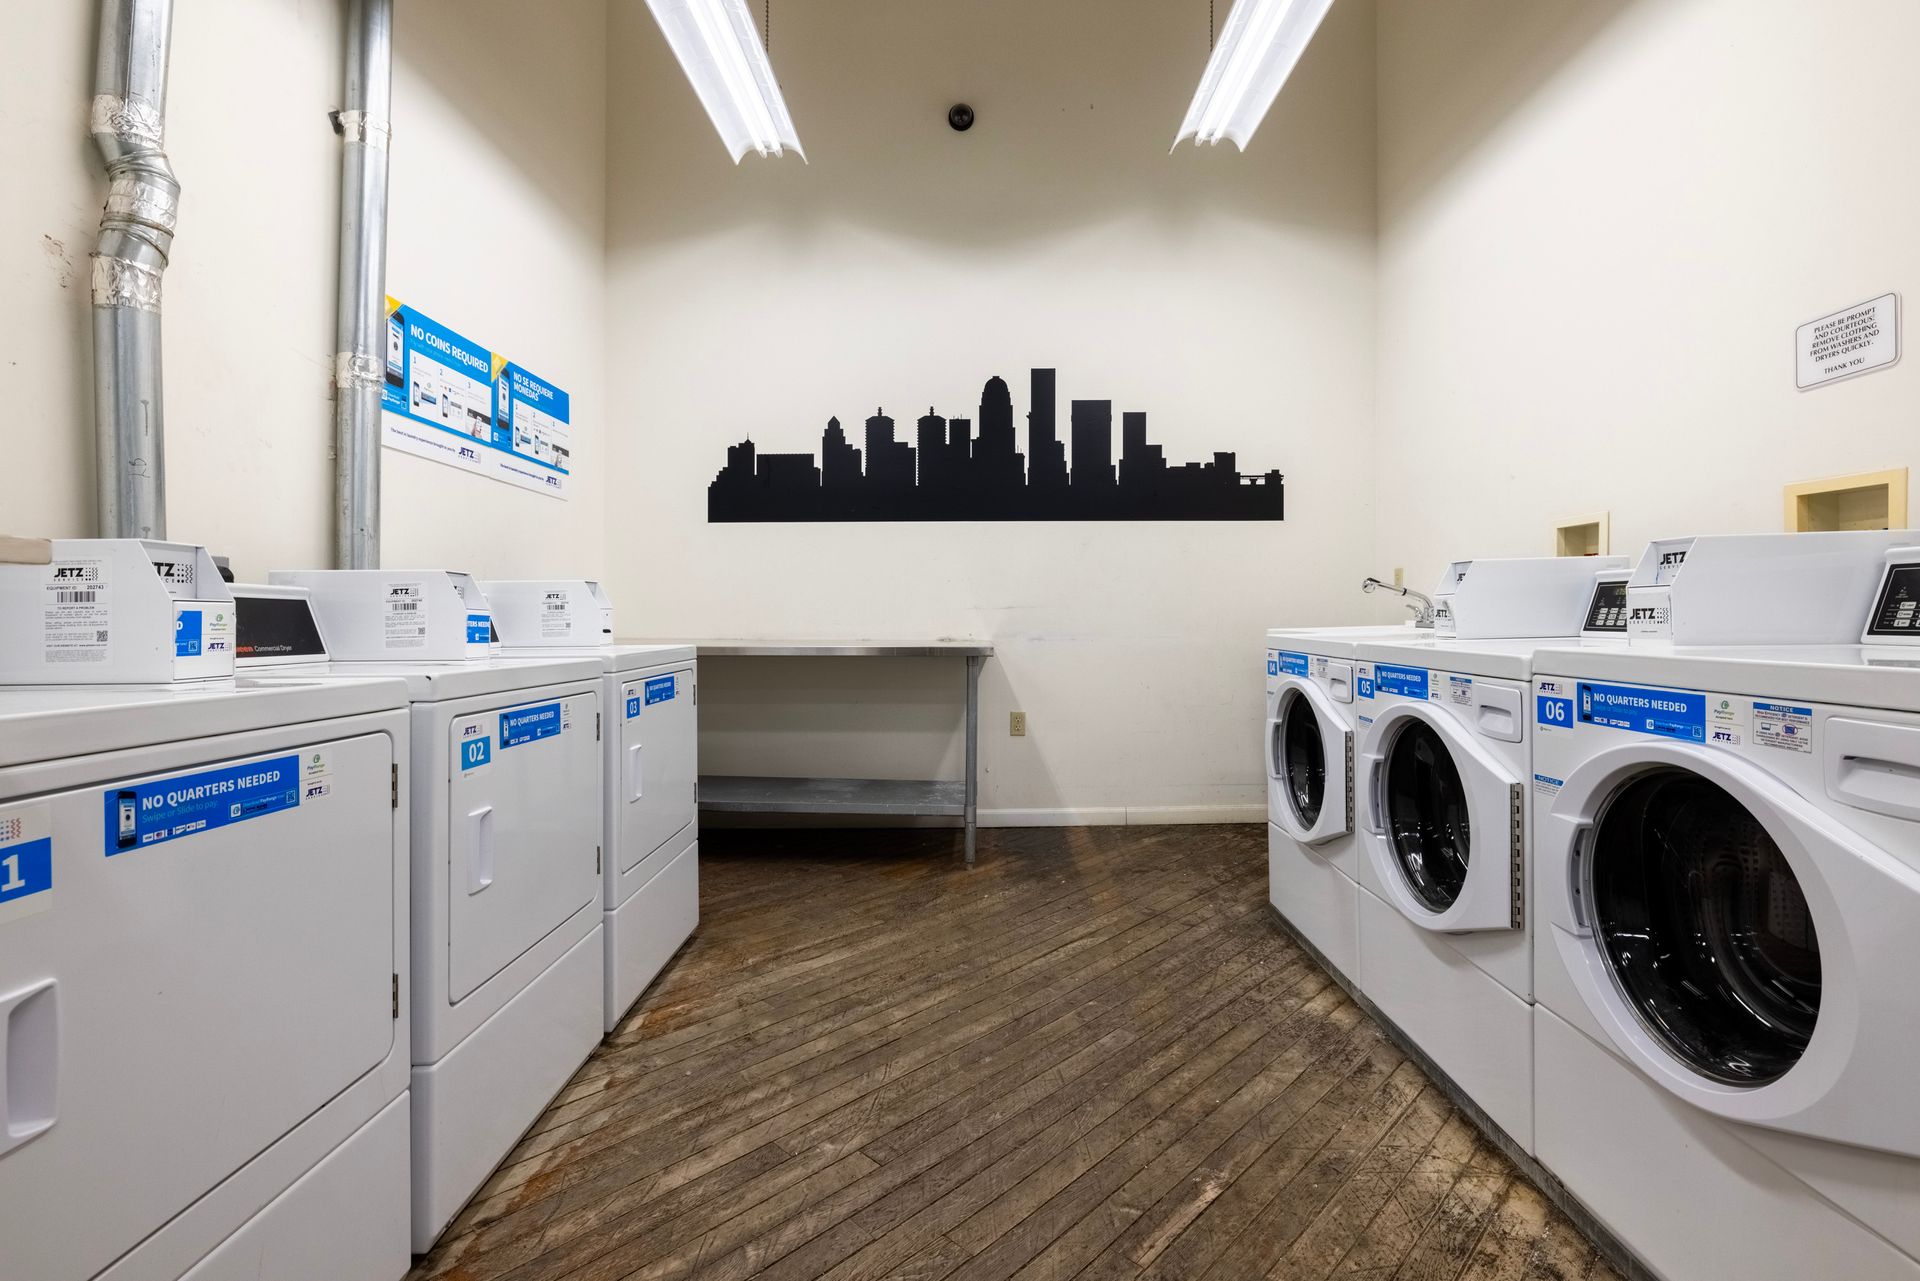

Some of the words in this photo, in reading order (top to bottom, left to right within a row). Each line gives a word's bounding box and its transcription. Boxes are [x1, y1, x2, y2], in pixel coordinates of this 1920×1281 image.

[1814, 322, 1837, 334] PLEASE
[1838, 317, 1845, 325] BE
[1846, 307, 1876, 322] PROMPT
[1810, 346, 1829, 356] FROM
[1831, 335, 1862, 350] WASHERS
[1863, 329, 1880, 341] AND
[1812, 336, 1840, 349] REMOVE
[1841, 322, 1877, 339] CLOTHING
[1815, 332, 1829, 341] AND
[410, 324, 424, 343] NO
[426, 333, 451, 355] COINS
[451, 346, 489, 374] REQUIRED
[1815, 351, 1840, 362] DRYERS
[1842, 341, 1874, 354] QUICKLY.
[1824, 363, 1848, 374] THANK
[1849, 357, 1865, 366] YOU
[513, 371, 522, 383] NO
[522, 376, 530, 387] SE
[529, 379, 554, 400] REQUIERE
[513, 381, 539, 401] MONEDAS
[459, 447, 474, 460] JETZ
[1660, 551, 1686, 566] JETZ
[54, 568, 83, 578] JETZ
[152, 562, 175, 577] TZ
[1629, 608, 1655, 619] JETZ
[1387, 673, 1406, 681] QUARTERS
[1405, 674, 1421, 682] NEEDED
[1361, 681, 1371, 694] 05
[1539, 682, 1555, 692] JETZ
[629, 700, 638, 714] 03
[1593, 692, 1605, 702] NO
[1606, 695, 1650, 708] QUARTERS
[1651, 699, 1687, 713] NEEDED
[1770, 705, 1793, 713] NOTICE
[1545, 700, 1565, 721] 06
[510, 718, 517, 726] NO
[518, 714, 539, 727] QUARTERS
[539, 711, 554, 721] NEEDED
[463, 725, 477, 735] JETZ
[1713, 732, 1731, 741] JETZ
[469, 741, 484, 762] 02
[142, 794, 164, 811] NO
[167, 779, 235, 808] QUARTERS
[237, 770, 281, 790] NEEDED
[306, 786, 322, 797] JETZ
[260, 795, 277, 804] PayRange
[142, 810, 166, 824] Swipe
[176, 803, 195, 814] Slide
[195, 801, 203, 809] to
[2, 854, 25, 892] 1
